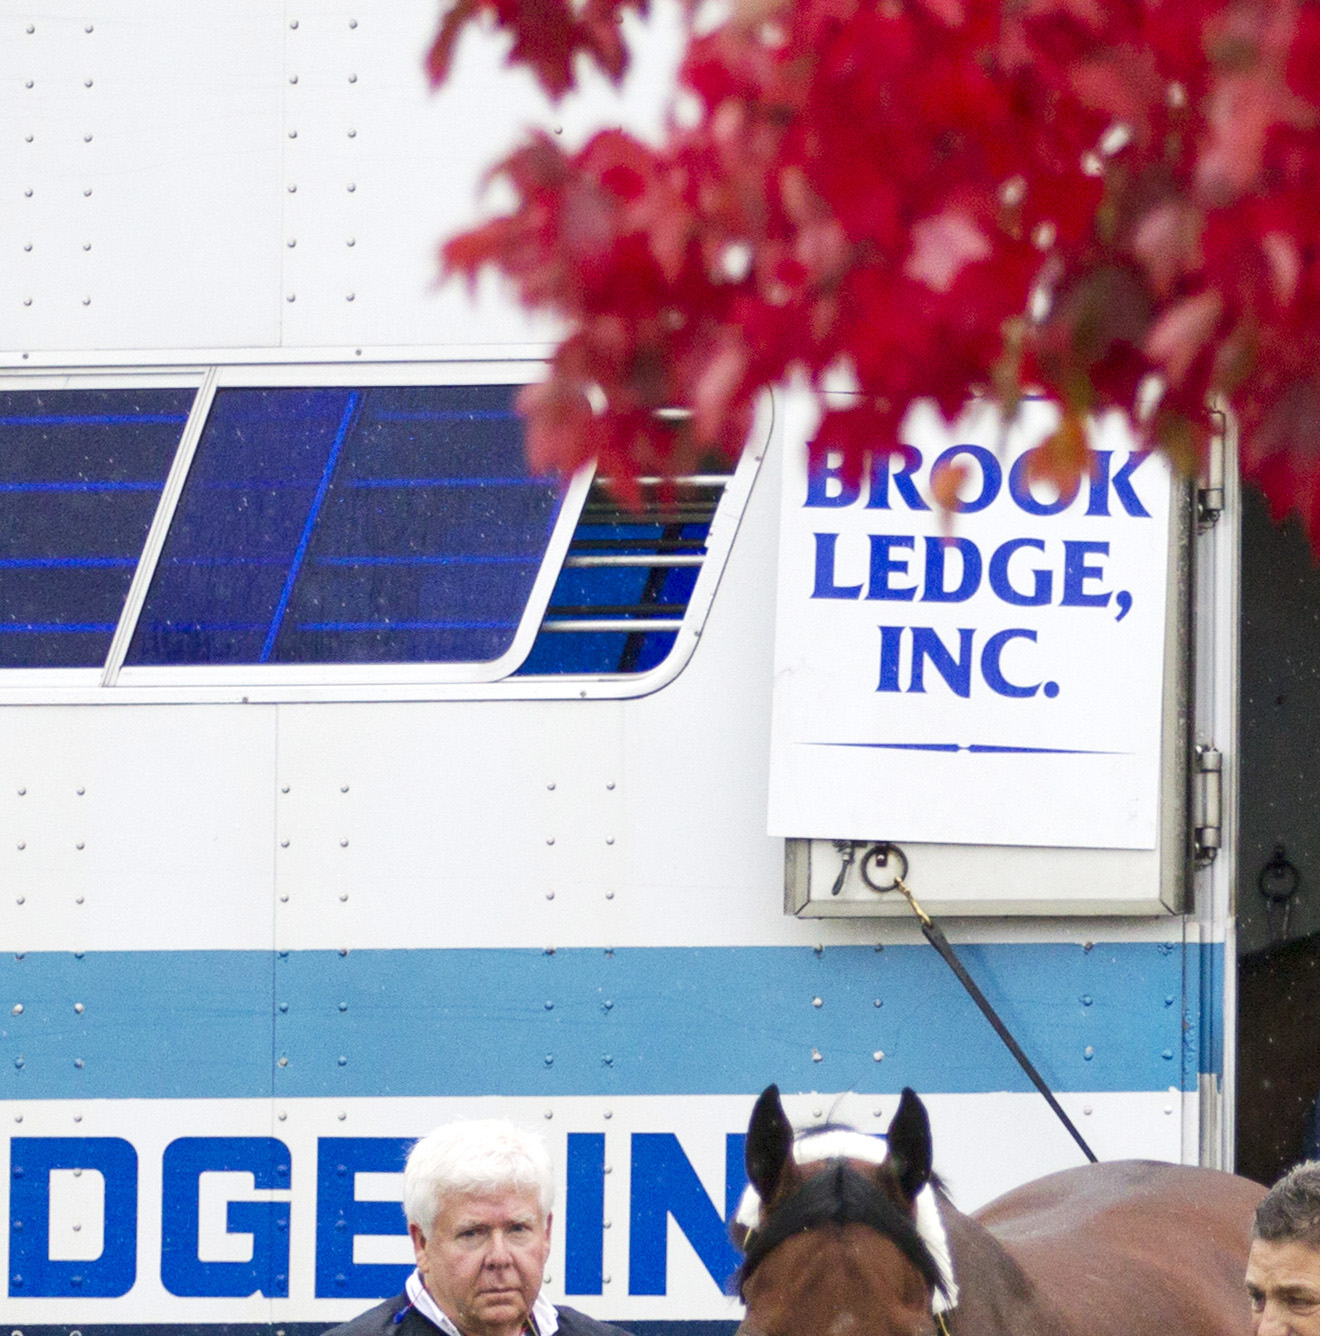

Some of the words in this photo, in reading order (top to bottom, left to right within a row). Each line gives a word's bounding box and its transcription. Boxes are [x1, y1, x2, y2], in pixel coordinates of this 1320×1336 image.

[803, 441, 1153, 517] BROOK
[809, 532, 1133, 623] LEDGE,
[875, 625, 1061, 699] INC.
